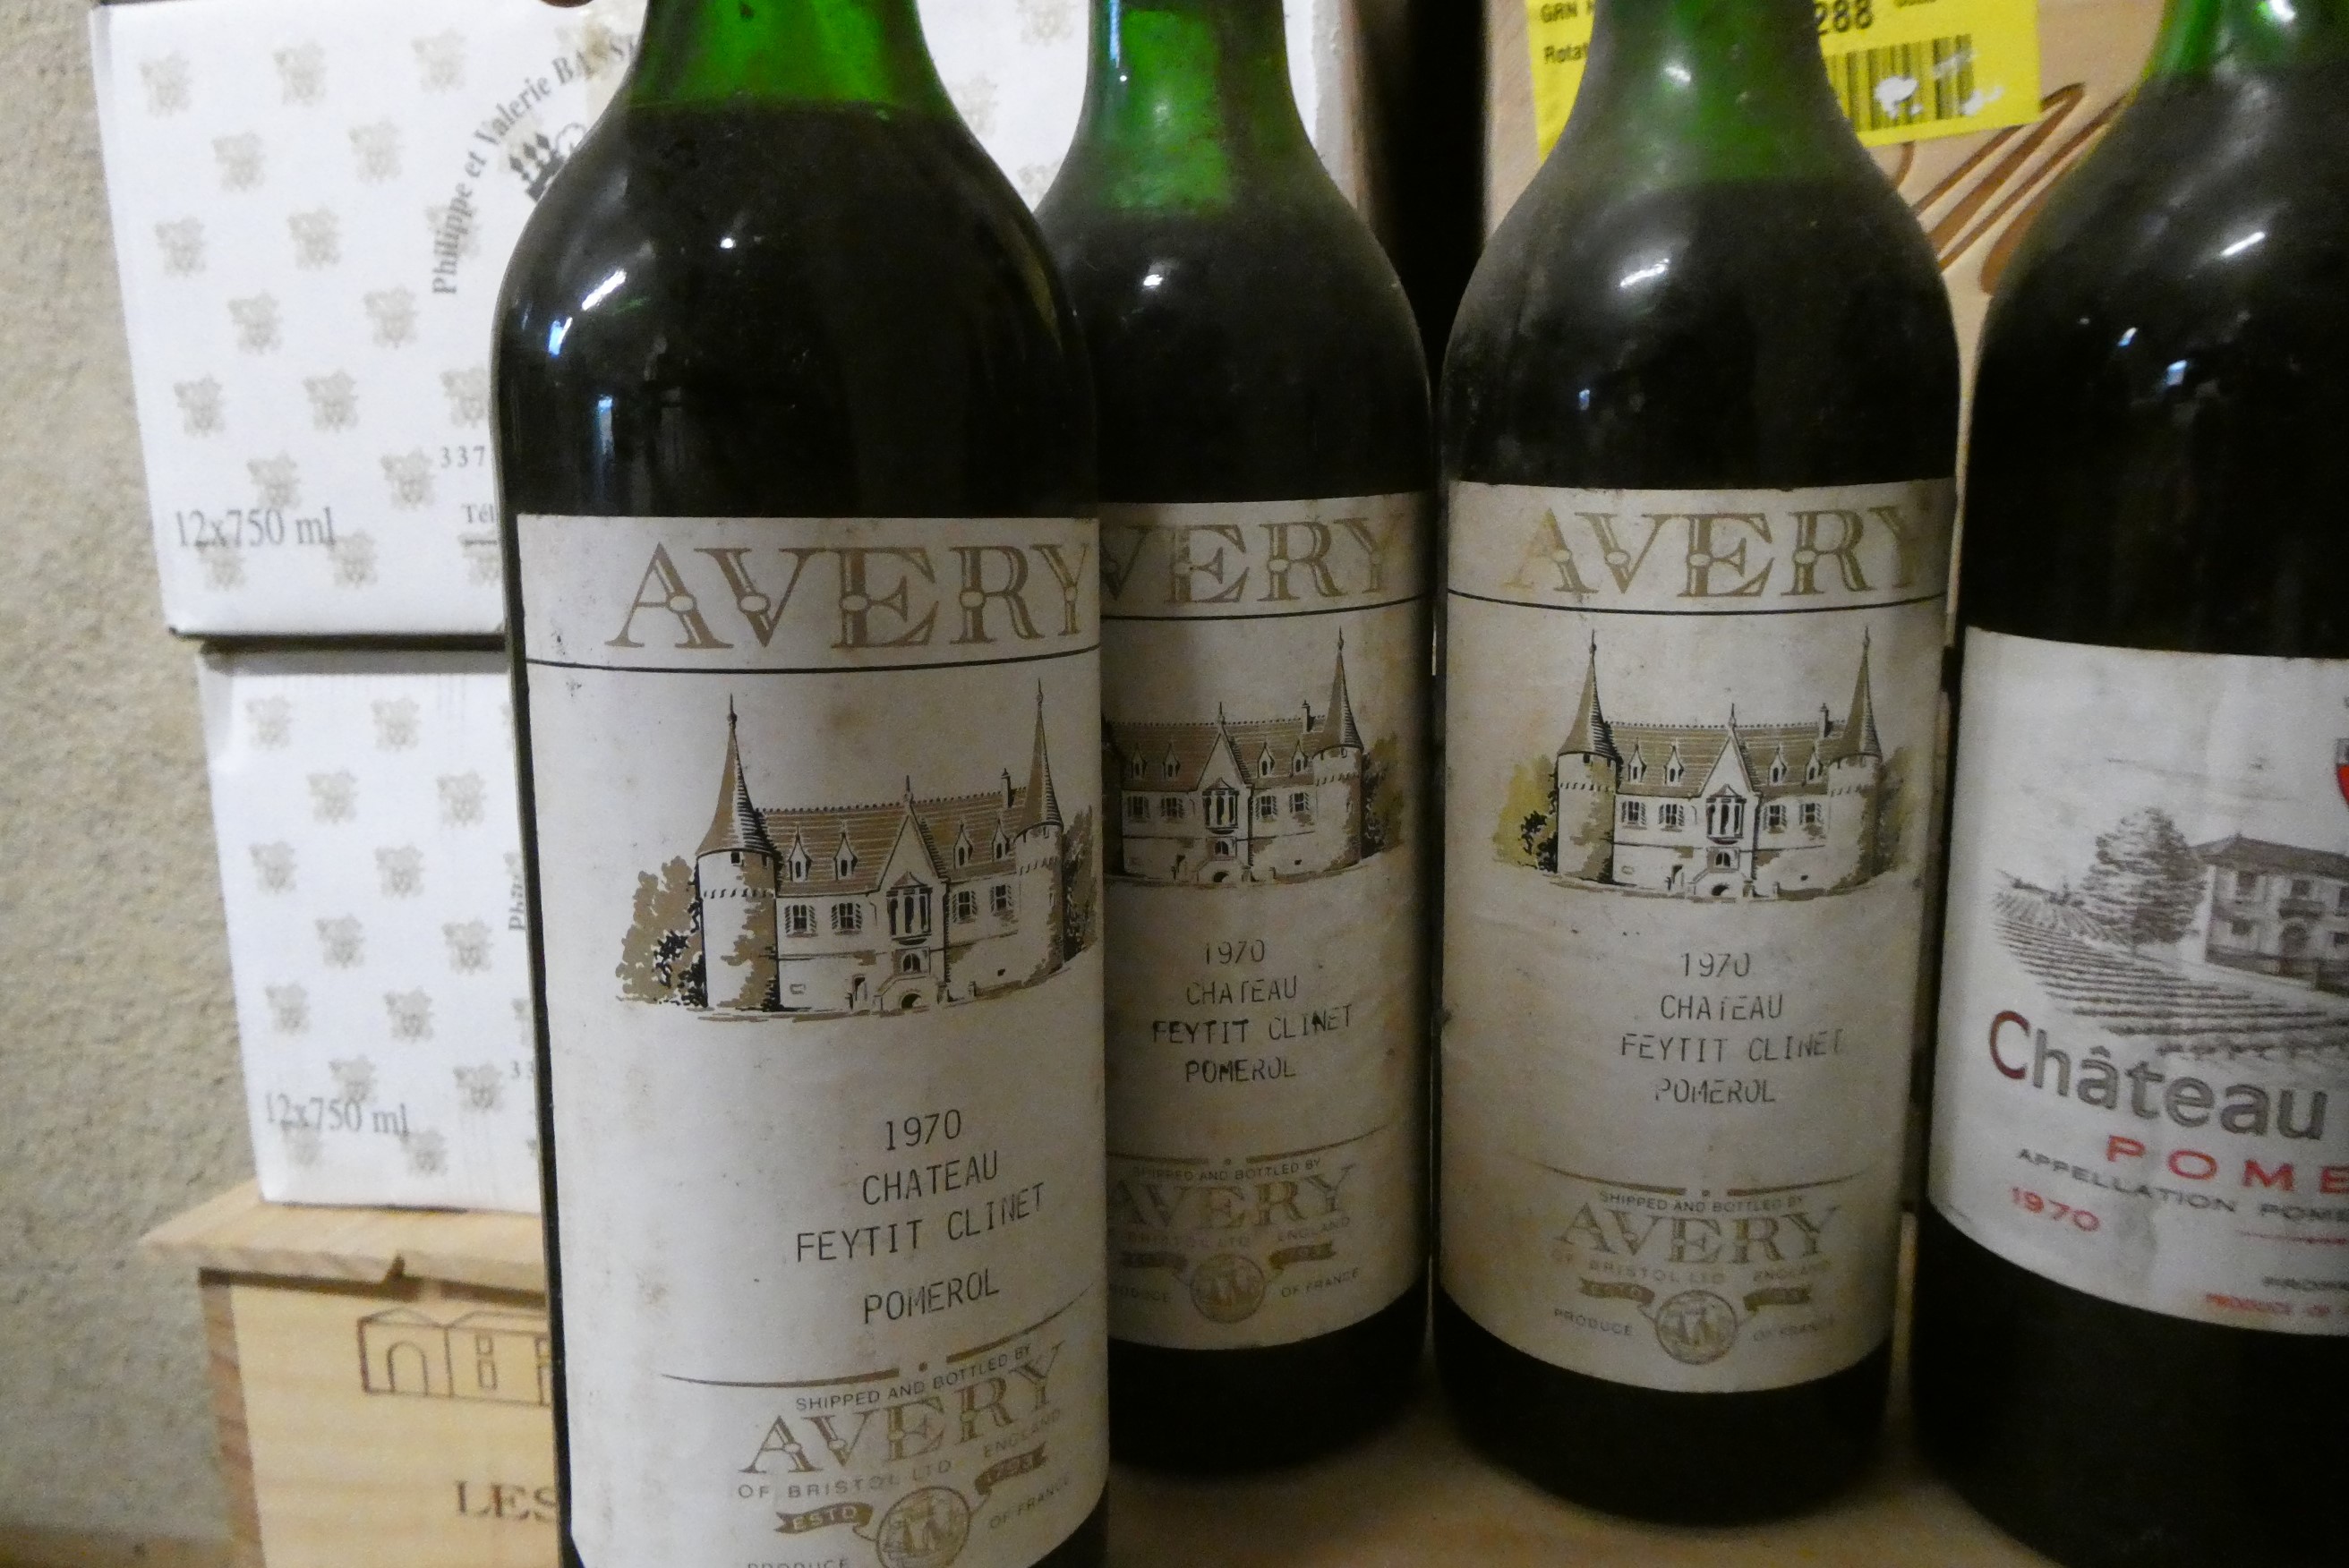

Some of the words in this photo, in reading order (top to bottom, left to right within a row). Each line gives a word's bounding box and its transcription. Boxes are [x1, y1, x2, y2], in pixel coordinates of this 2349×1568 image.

[465, 150, 487, 179] et
[175, 507, 286, 548] 12x750
[295, 506, 336, 548] ml
[1501, 504, 1930, 598] AVERY
[605, 541, 1089, 649] AVERY
[1204, 939, 1266, 966] 1970
[1681, 952, 1751, 977] 1970
[1186, 976, 1298, 1006] CHATEAU
[1660, 993, 1783, 1021] CHATEAU
[1152, 1018, 1250, 1045] FEYTIT
[1268, 1003, 1353, 1042] CLINET
[1620, 1032, 1729, 1063] FEYTIT
[1748, 1028, 1844, 1062] CLINET
[1185, 1057, 1297, 1084] POMEROL
[1655, 1078, 1776, 1104] POMEROL
[1987, 1010, 2328, 1141] Château
[265, 1091, 360, 1131] 12x750
[372, 1102, 411, 1137] ml
[884, 1109, 962, 1152] 1970
[861, 1150, 998, 1206] CHATEAU
[1200, 1169, 1228, 1181] AND
[1234, 1163, 1300, 1180] BOTTLED
[1305, 1158, 1321, 1171] BY
[2017, 1148, 2237, 1214] APPELLATION
[796, 1219, 924, 1263] FEYTIT
[946, 1181, 1046, 1241] CLINET
[1599, 1191, 1668, 1211] SHIPPED
[2012, 1186, 2101, 1233] 1970
[1553, 1202, 1841, 1265] AVERY
[864, 1267, 1001, 1325] POMEROL
[795, 1388, 881, 1412] SHIPPED
[887, 1379, 927, 1401] AND
[933, 1357, 1011, 1390] BOTTLED
[1012, 1345, 1032, 1364] BY
[739, 1340, 1067, 1474] AVERY
[456, 1479, 559, 1521] LES
[738, 1484, 771, 1500] OF
[788, 1473, 898, 1500] BRISTOL
[911, 1458, 952, 1482] LTD
